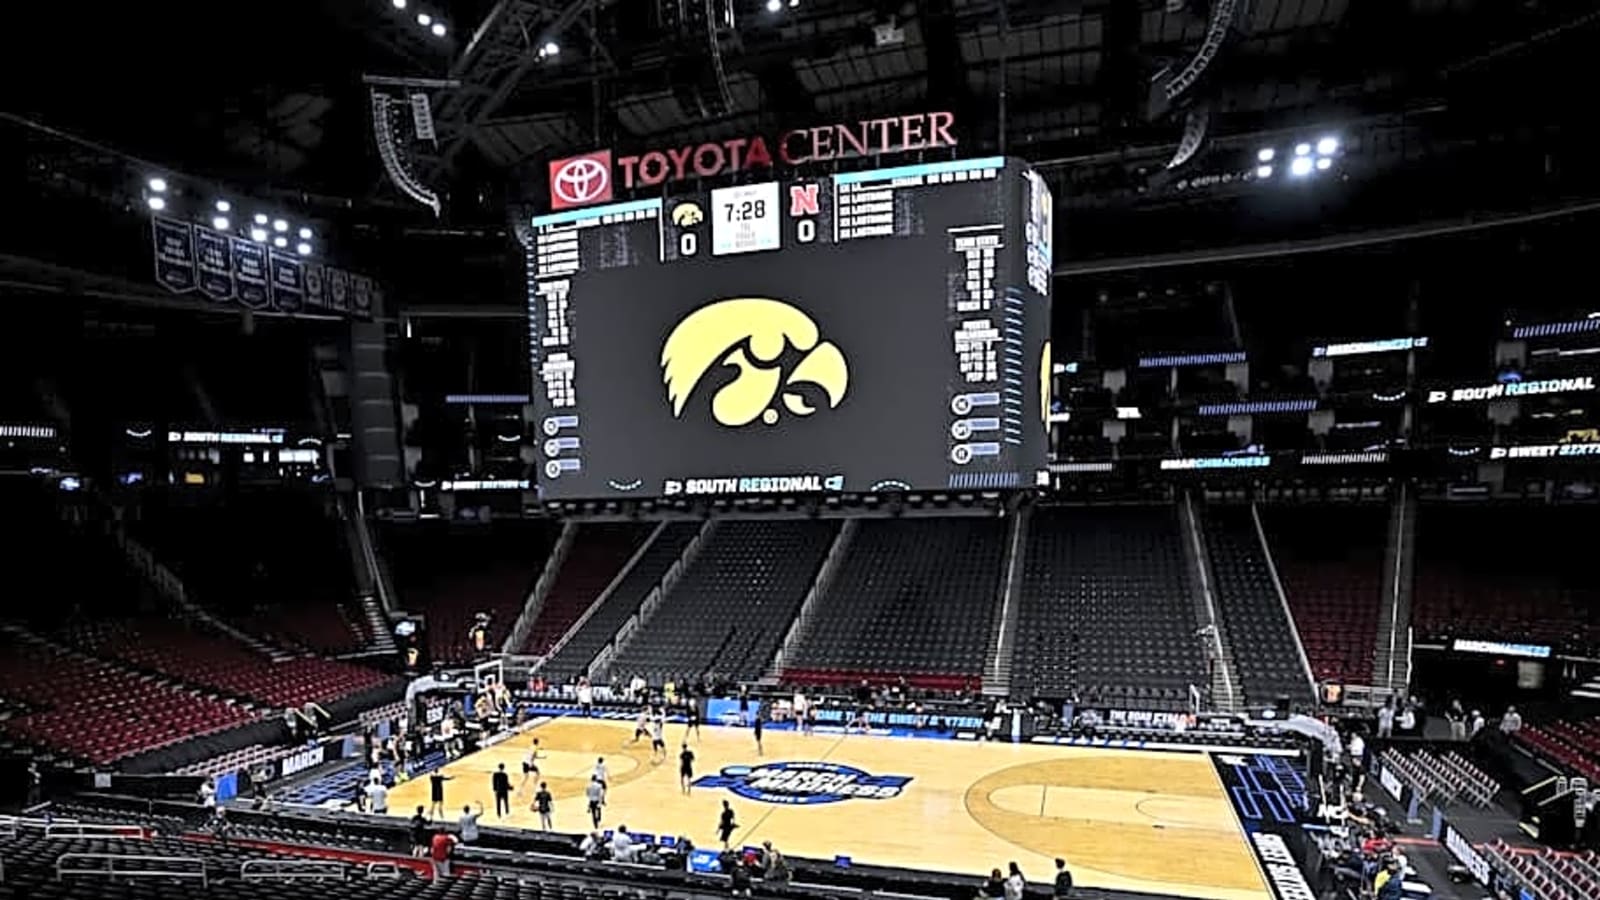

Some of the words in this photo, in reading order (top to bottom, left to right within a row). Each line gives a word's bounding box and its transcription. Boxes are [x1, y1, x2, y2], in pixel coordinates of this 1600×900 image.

[618, 136, 772, 188] TOYOTA
[779, 112, 958, 165] CENTER
[723, 200, 766, 222] 7:28
[798, 219, 815, 242] 0
[680, 233, 696, 255] 0
[1452, 384, 1505, 401] SOUTH
[1505, 377, 1595, 396] REGIONAL
[1508, 445, 1559, 458] SWEET
[686, 478, 737, 494] SOUTH
[739, 476, 822, 492] REGIONAL
[282, 747, 324, 776] MARCH
[748, 768, 857, 788] MARCH
[749, 776, 901, 798] MADNESS
